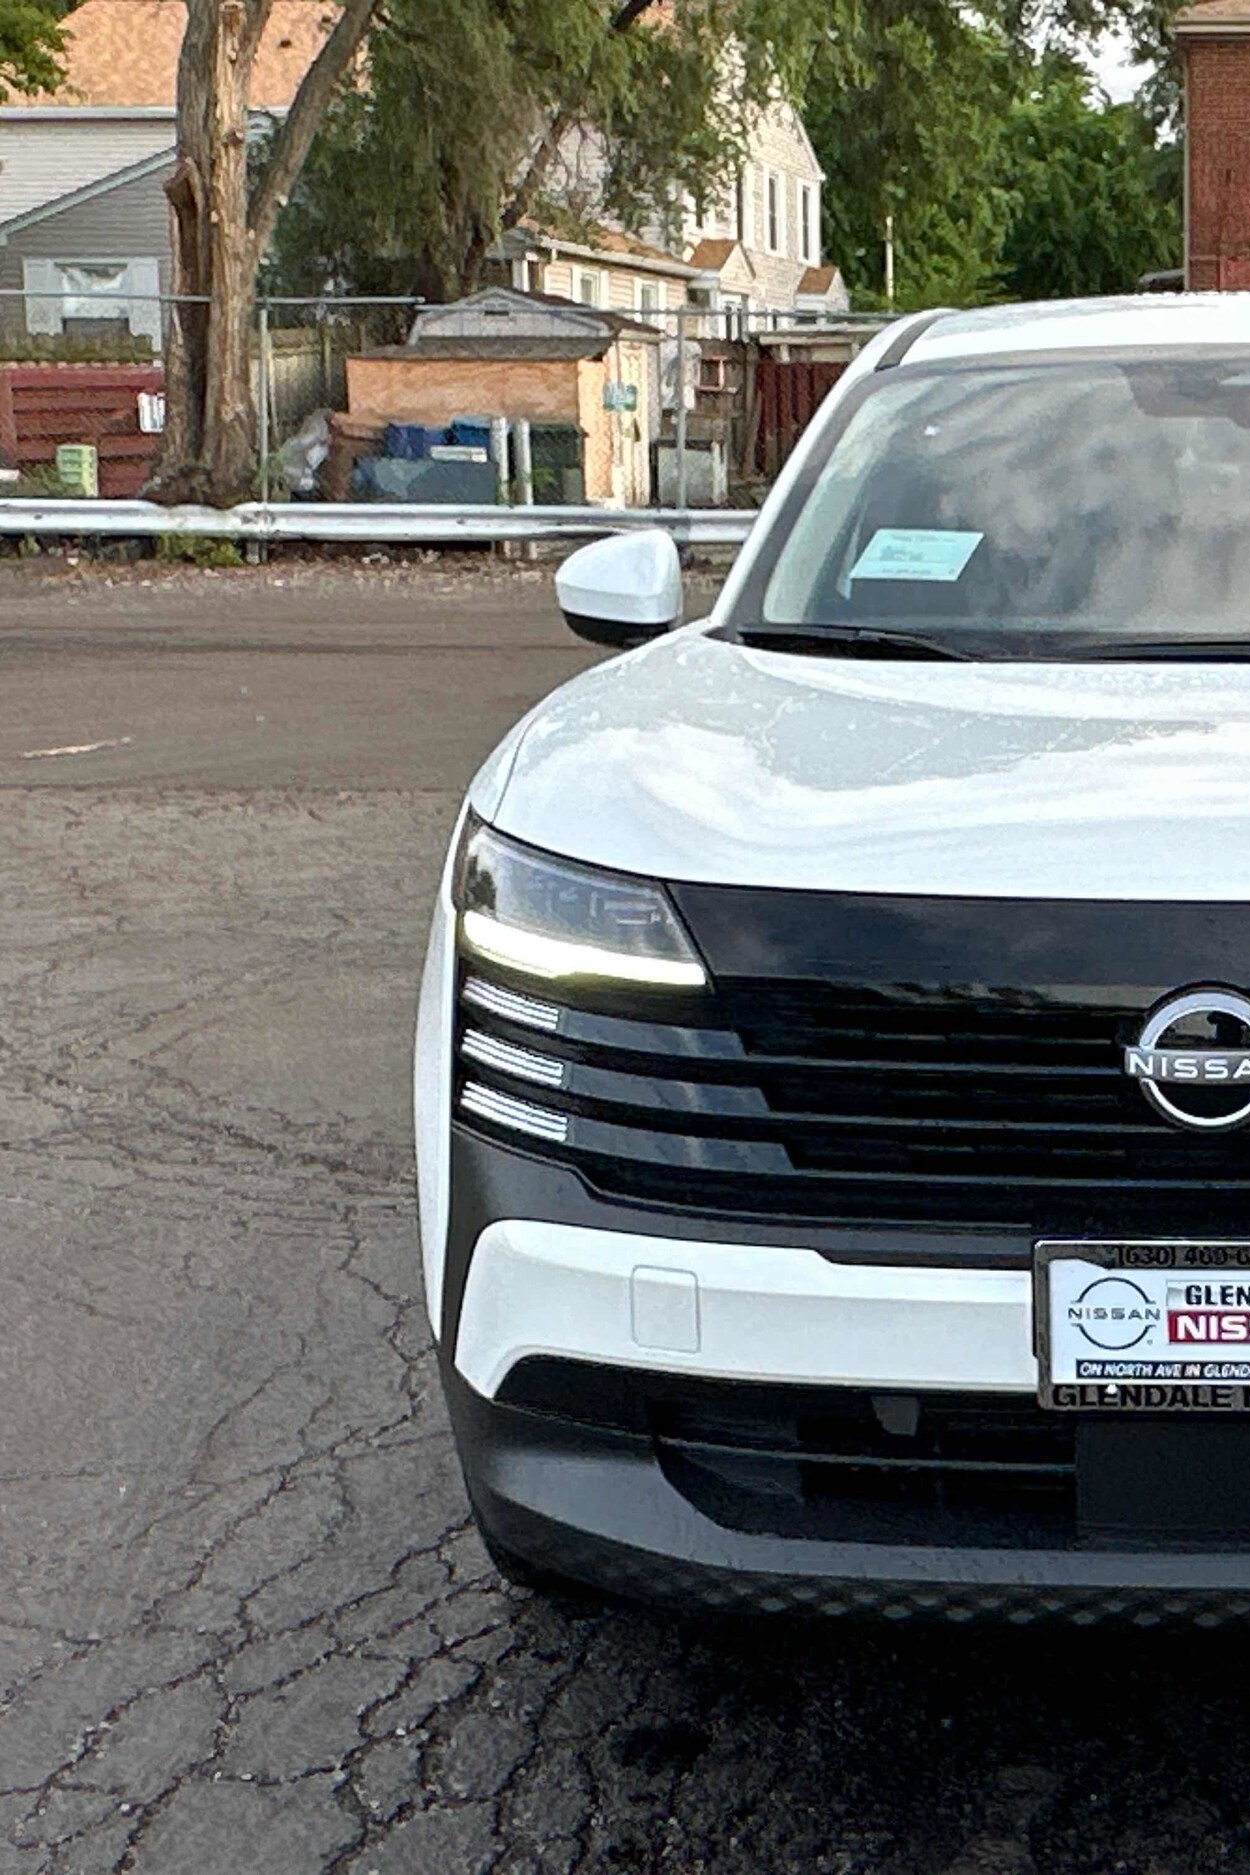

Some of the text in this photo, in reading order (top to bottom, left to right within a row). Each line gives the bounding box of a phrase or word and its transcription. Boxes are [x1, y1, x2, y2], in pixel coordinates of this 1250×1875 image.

[1068, 1306, 1161, 1321] NISSAN
[1080, 1361, 1102, 1376] ON
[1103, 1361, 1153, 1377] NORTH
[1154, 1363, 1182, 1378] AVE
[1184, 1363, 1201, 1378] IN
[1052, 1384, 1232, 1408] GLENDALE
